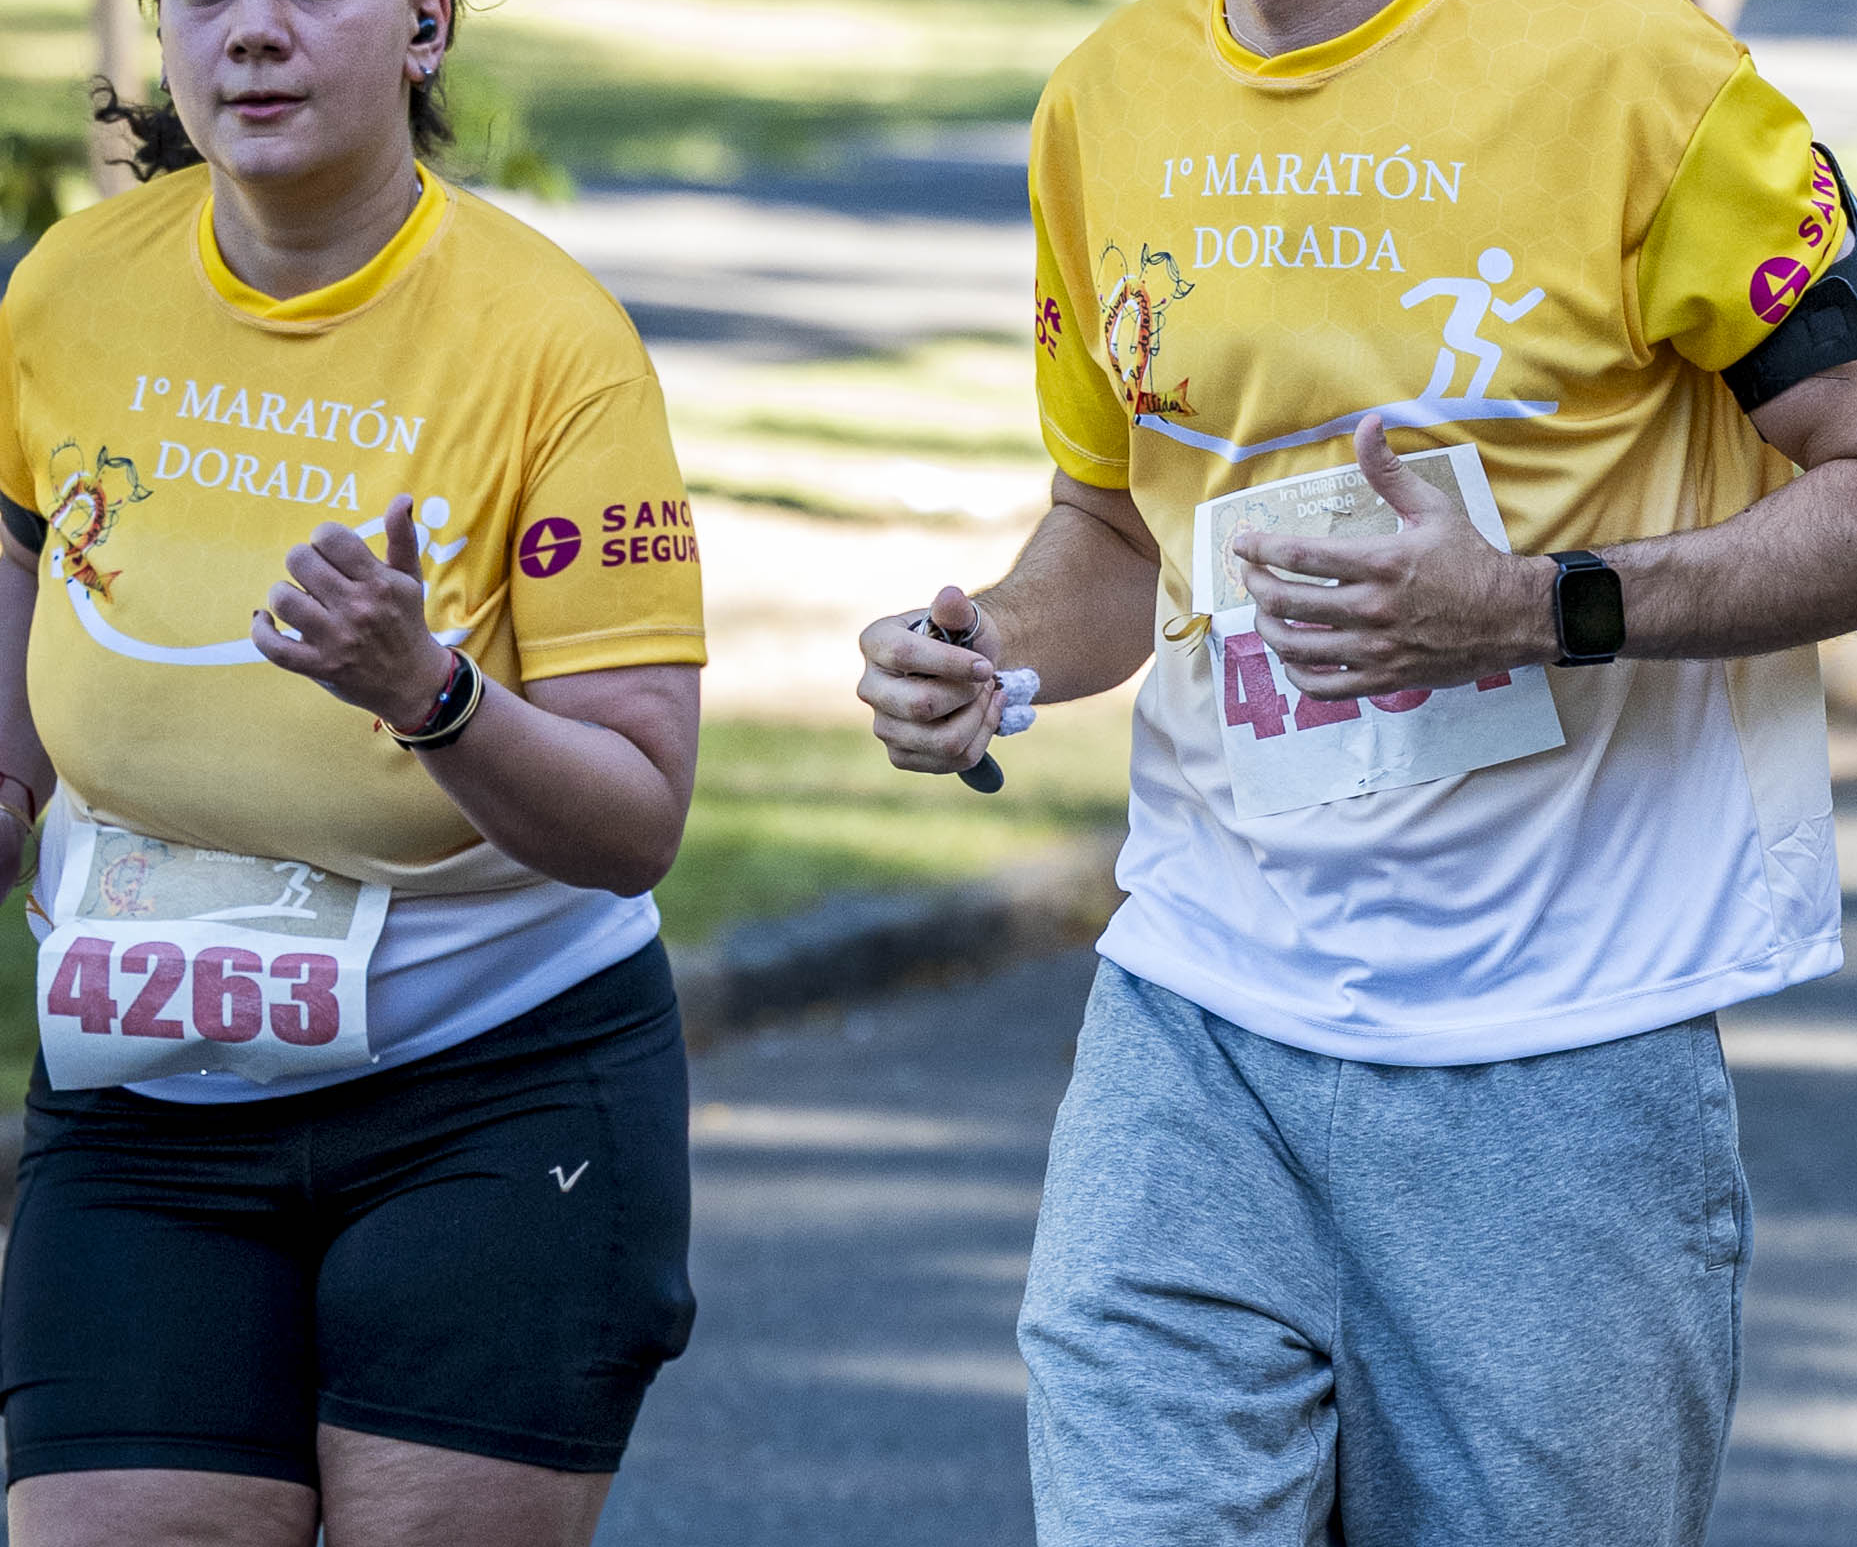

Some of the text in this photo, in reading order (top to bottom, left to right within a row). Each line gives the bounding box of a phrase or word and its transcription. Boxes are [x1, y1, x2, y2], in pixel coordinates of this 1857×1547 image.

[1200, 143, 1466, 204] MARATÓN
[1192, 224, 1407, 273] DORADA
[176, 379, 426, 456] MARATÓN
[153, 440, 361, 512] DORADA
[47, 936, 341, 1047] 4263
